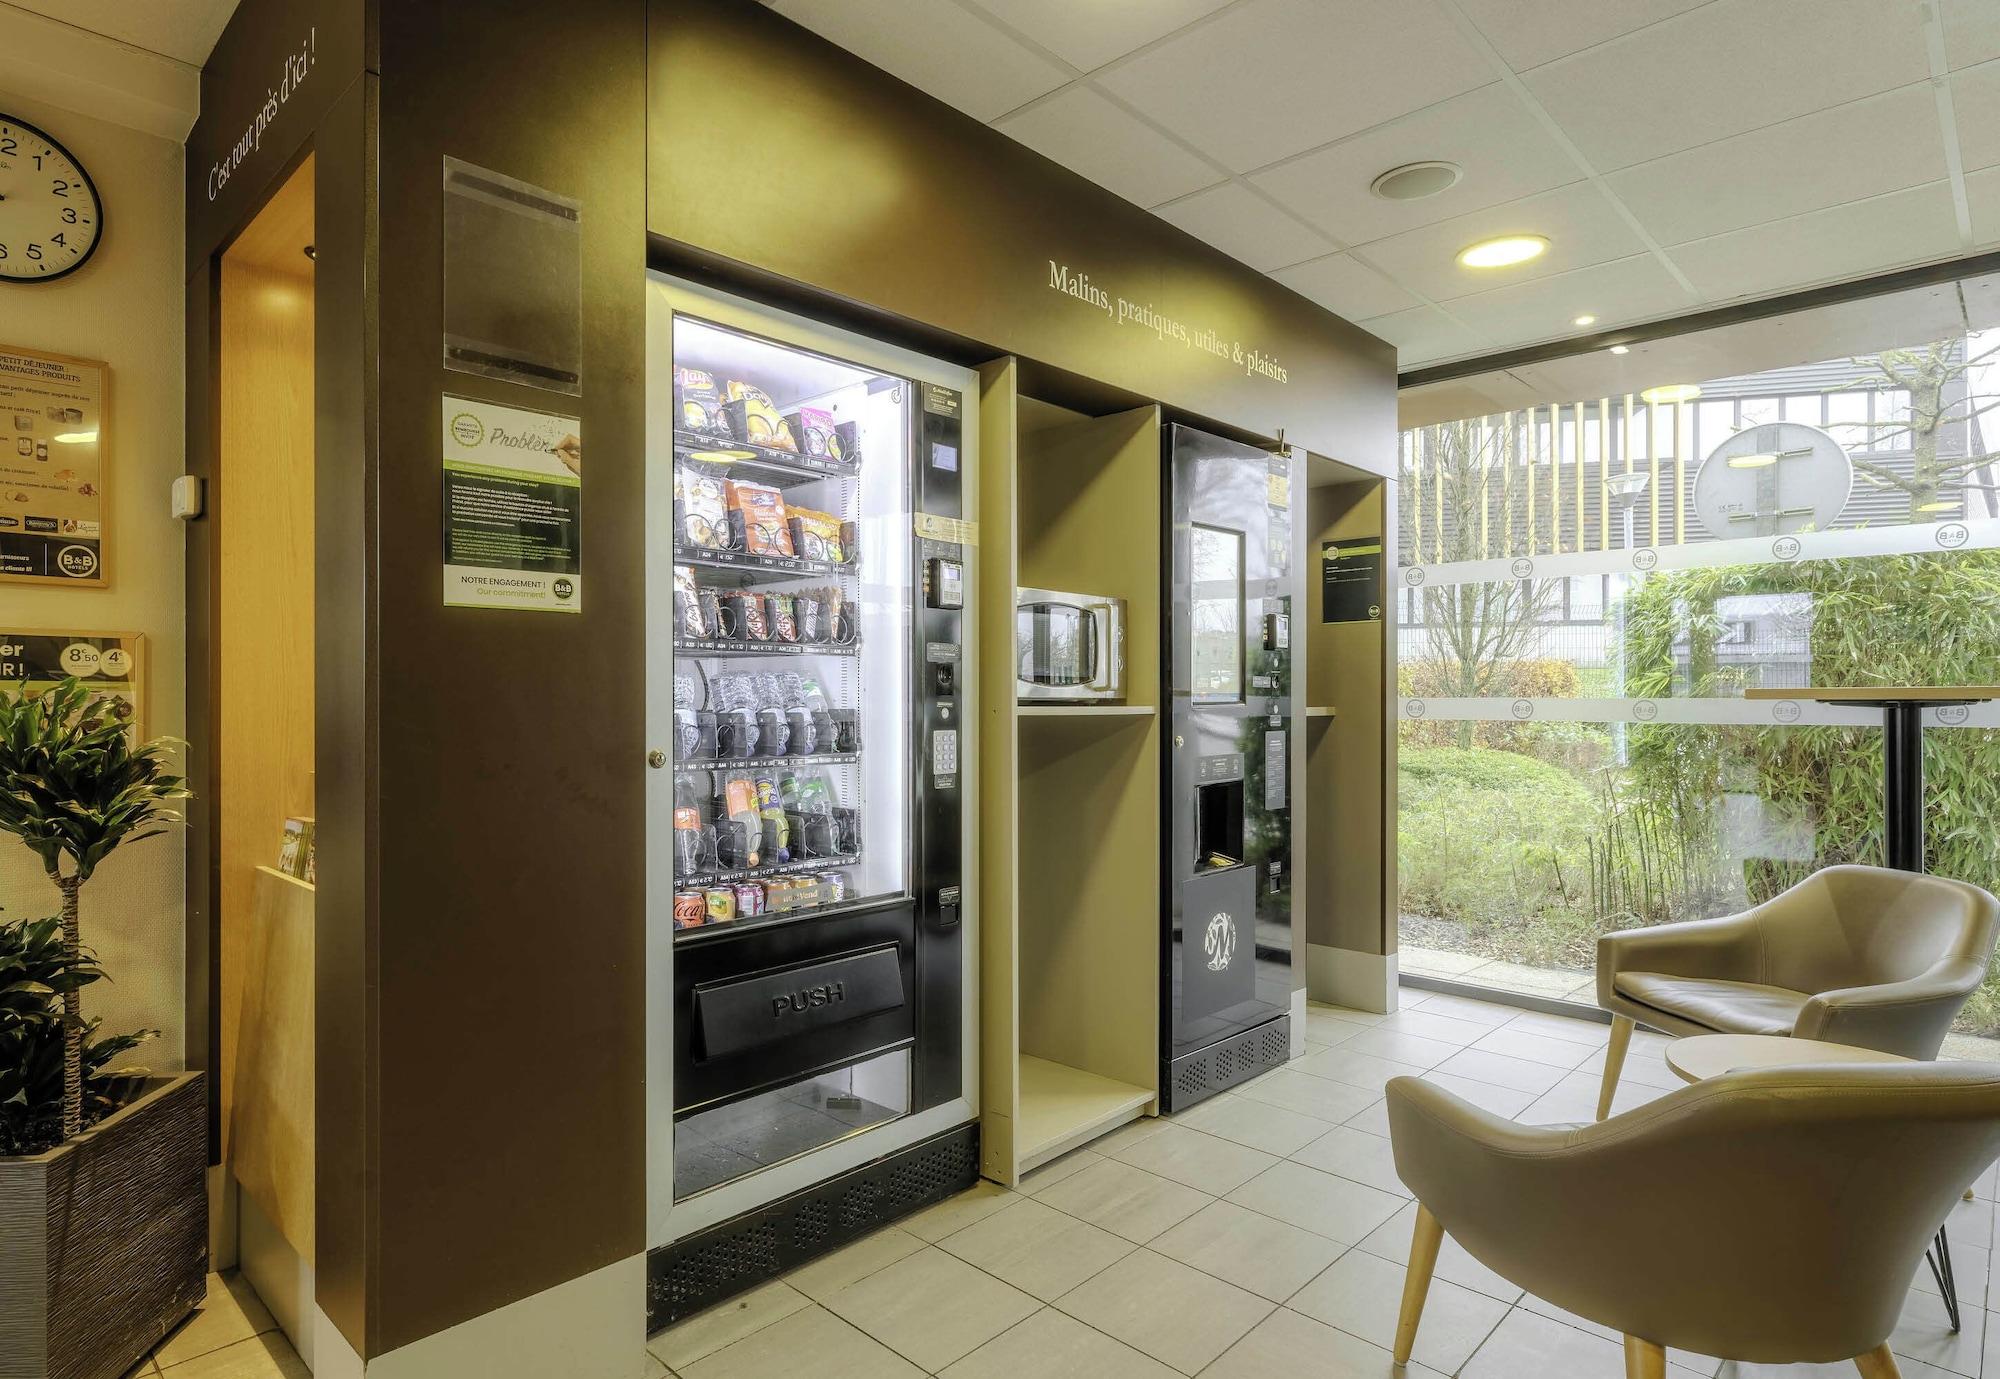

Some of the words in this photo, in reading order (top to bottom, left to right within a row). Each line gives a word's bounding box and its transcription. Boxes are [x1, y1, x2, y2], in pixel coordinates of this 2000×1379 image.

[232, 125, 253, 169] tout
[255, 88, 278, 152] près
[32, 155, 41, 171] 1
[52, 180, 68, 197] 2
[61, 207, 76, 224] 3
[51, 232, 66, 247] 4
[26, 243, 42, 260] 5
[1049, 260, 1114, 317] Malins,
[1117, 297, 1190, 348] pratiques,
[1195, 328, 1229, 359] utiles
[1232, 341, 1244, 365] &
[1247, 350, 1288, 384] plaisirs
[42, 370, 81, 383] PRODUITS
[461, 576, 488, 585] NOTRE
[489, 578, 542, 588] ENGAGEMENT
[477, 588, 492, 596] Our
[0, 644, 24, 657] er
[0, 663, 15, 676] R
[772, 981, 843, 1018] PUSH
